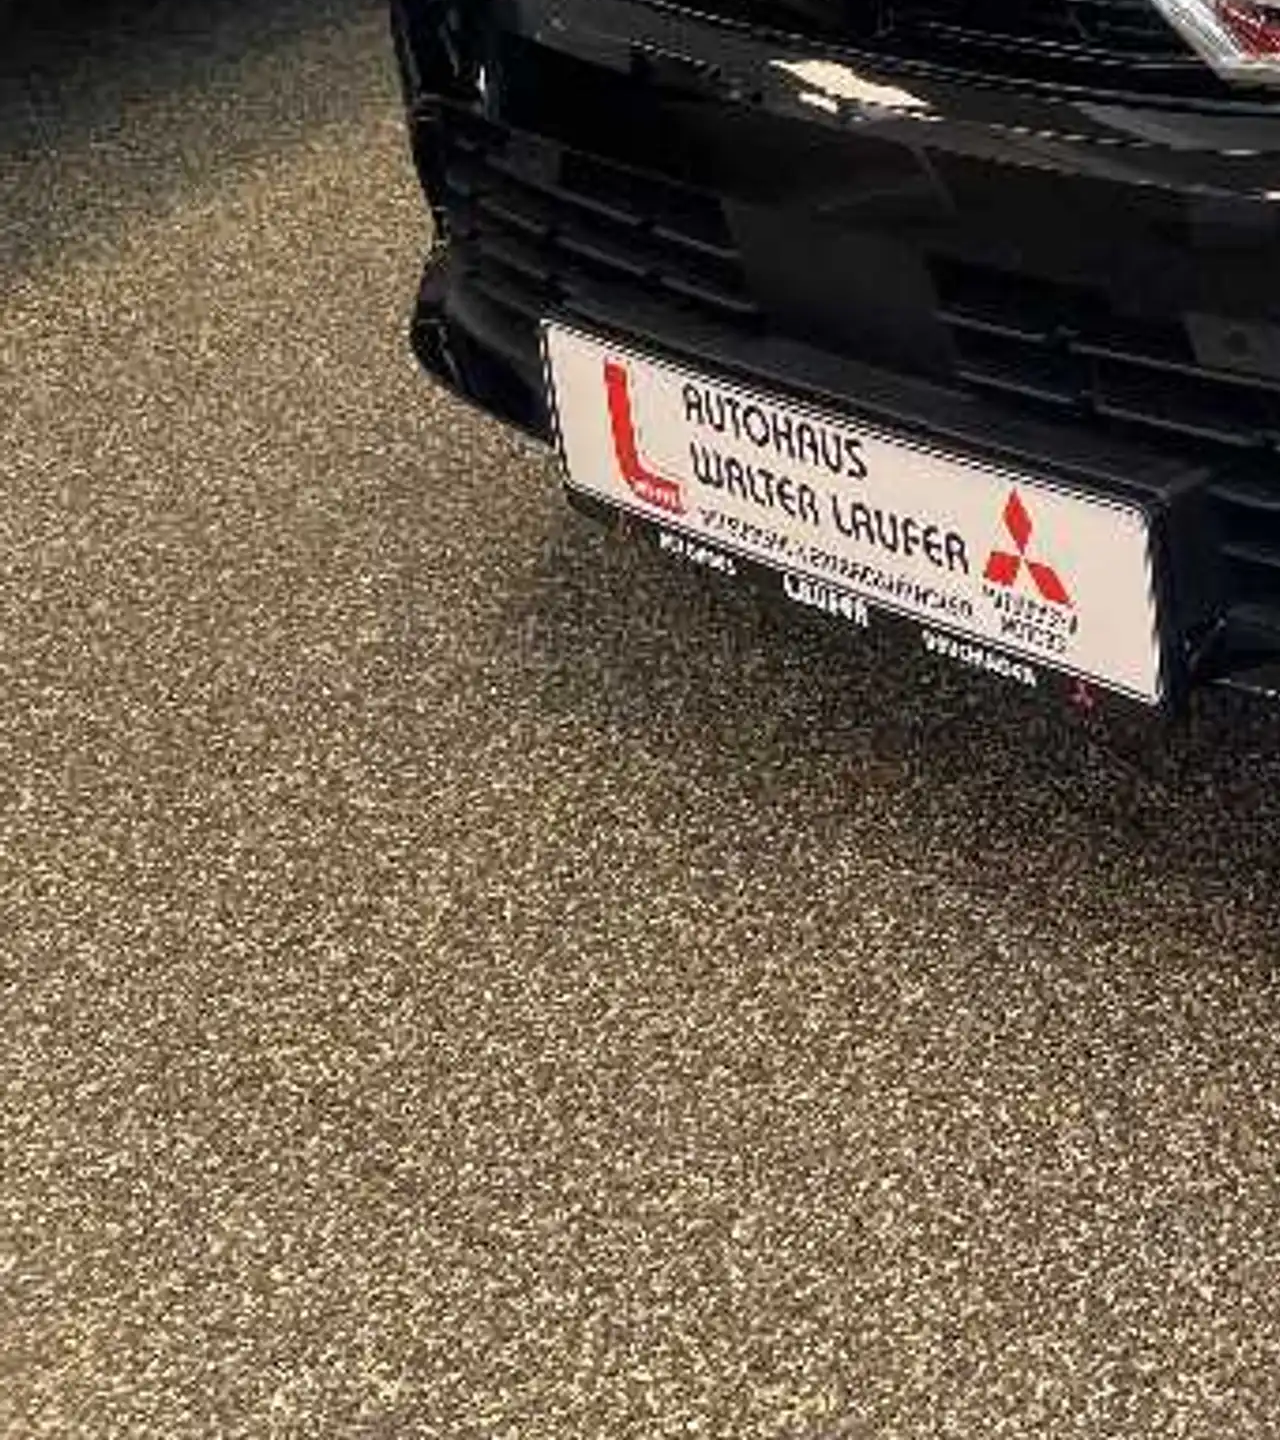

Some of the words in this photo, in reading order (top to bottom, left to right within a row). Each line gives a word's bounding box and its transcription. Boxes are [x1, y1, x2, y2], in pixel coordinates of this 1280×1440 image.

[683, 382, 868, 480] AUTOHAUS
[689, 440, 820, 526] WALTER
[831, 493, 970, 576] LAUFER
